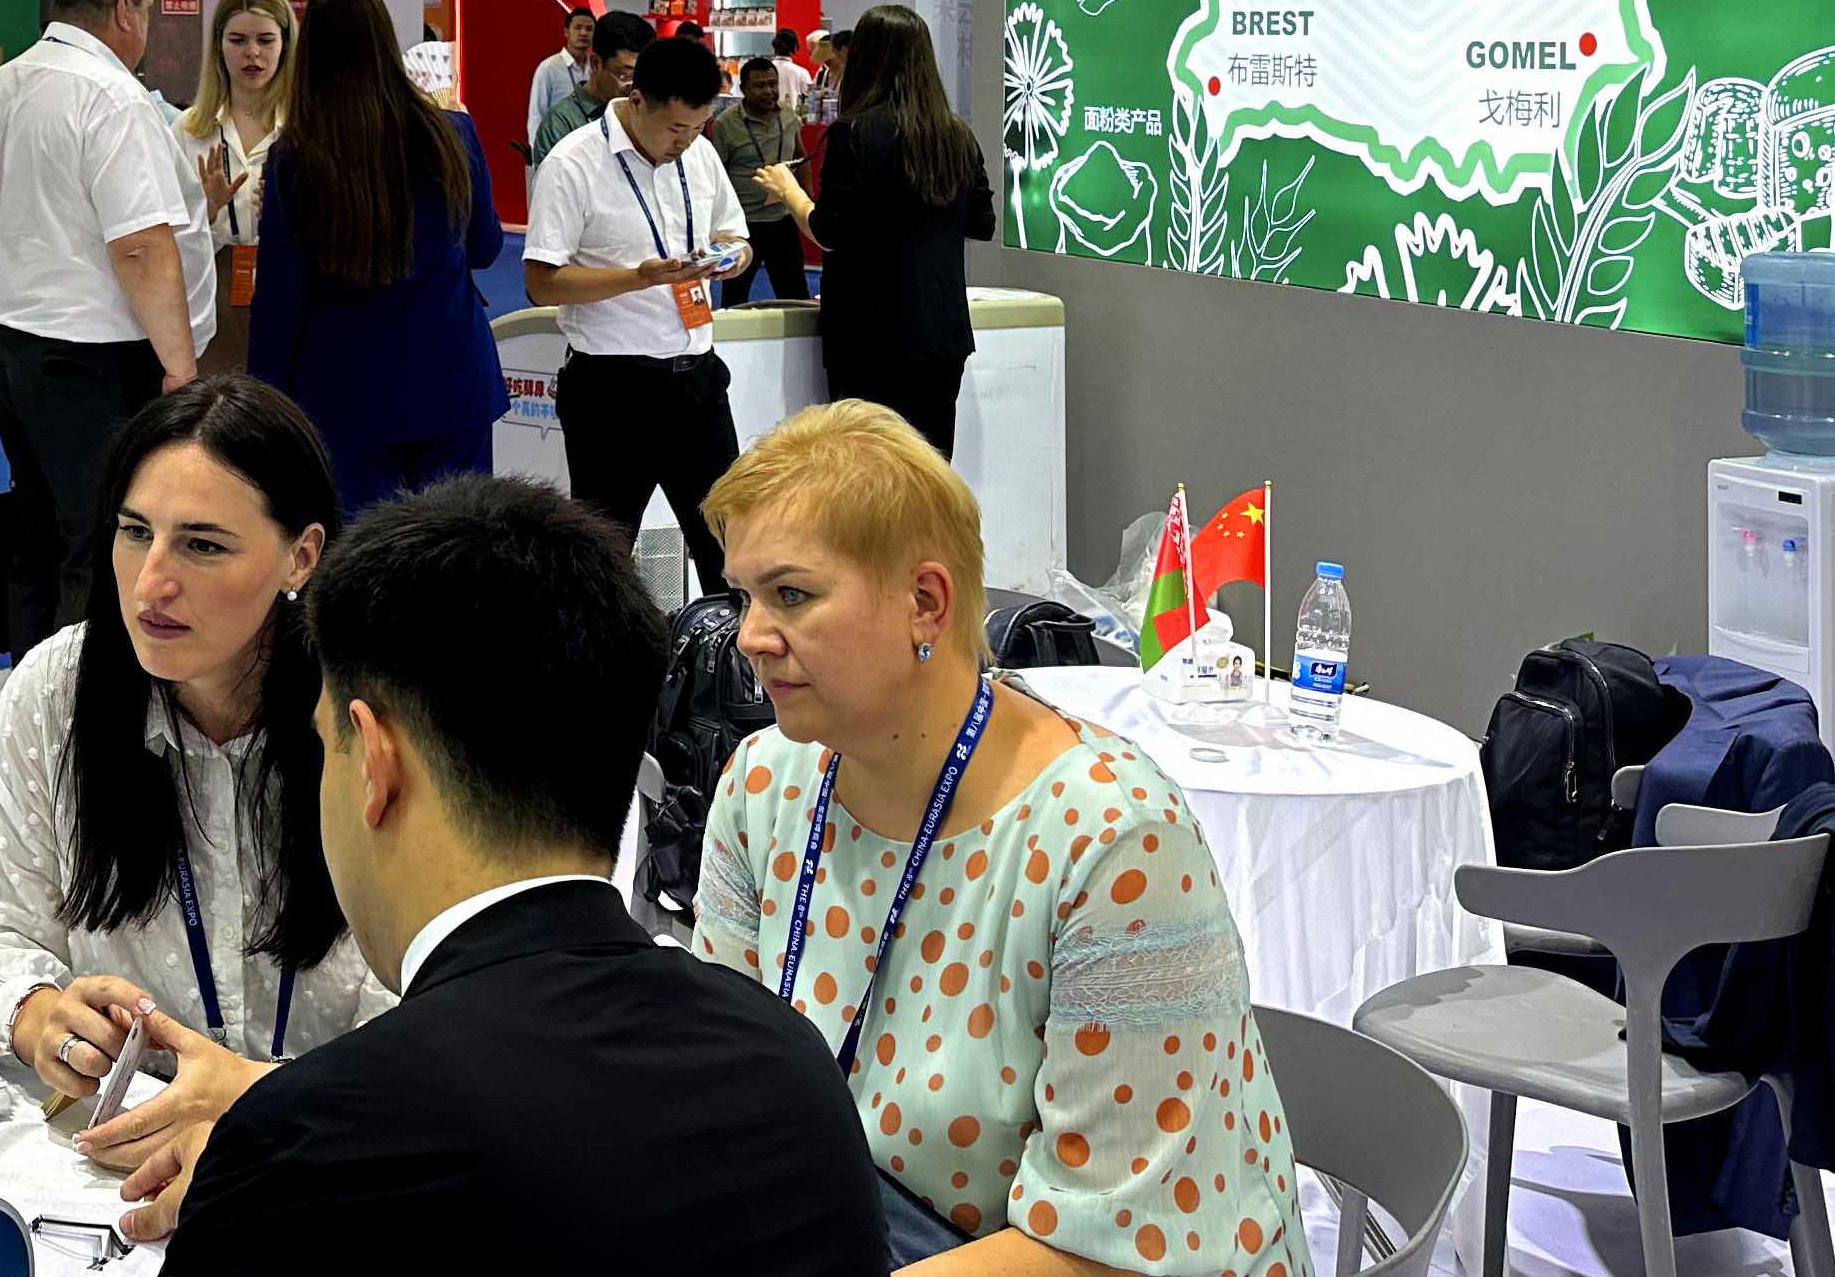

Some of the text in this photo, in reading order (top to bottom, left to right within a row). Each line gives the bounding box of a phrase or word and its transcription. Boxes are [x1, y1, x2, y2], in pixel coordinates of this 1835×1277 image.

[1231, 9, 1315, 37] BREST
[1227, 52, 1318, 89] 布雷斯特
[1465, 39, 1577, 72] GOMEL
[1083, 106, 1163, 138] 面粉类产品
[1478, 88, 1562, 129] 戈梅利
[943, 765, 959, 794] EXPO
[182, 899, 198, 927] EXPO
